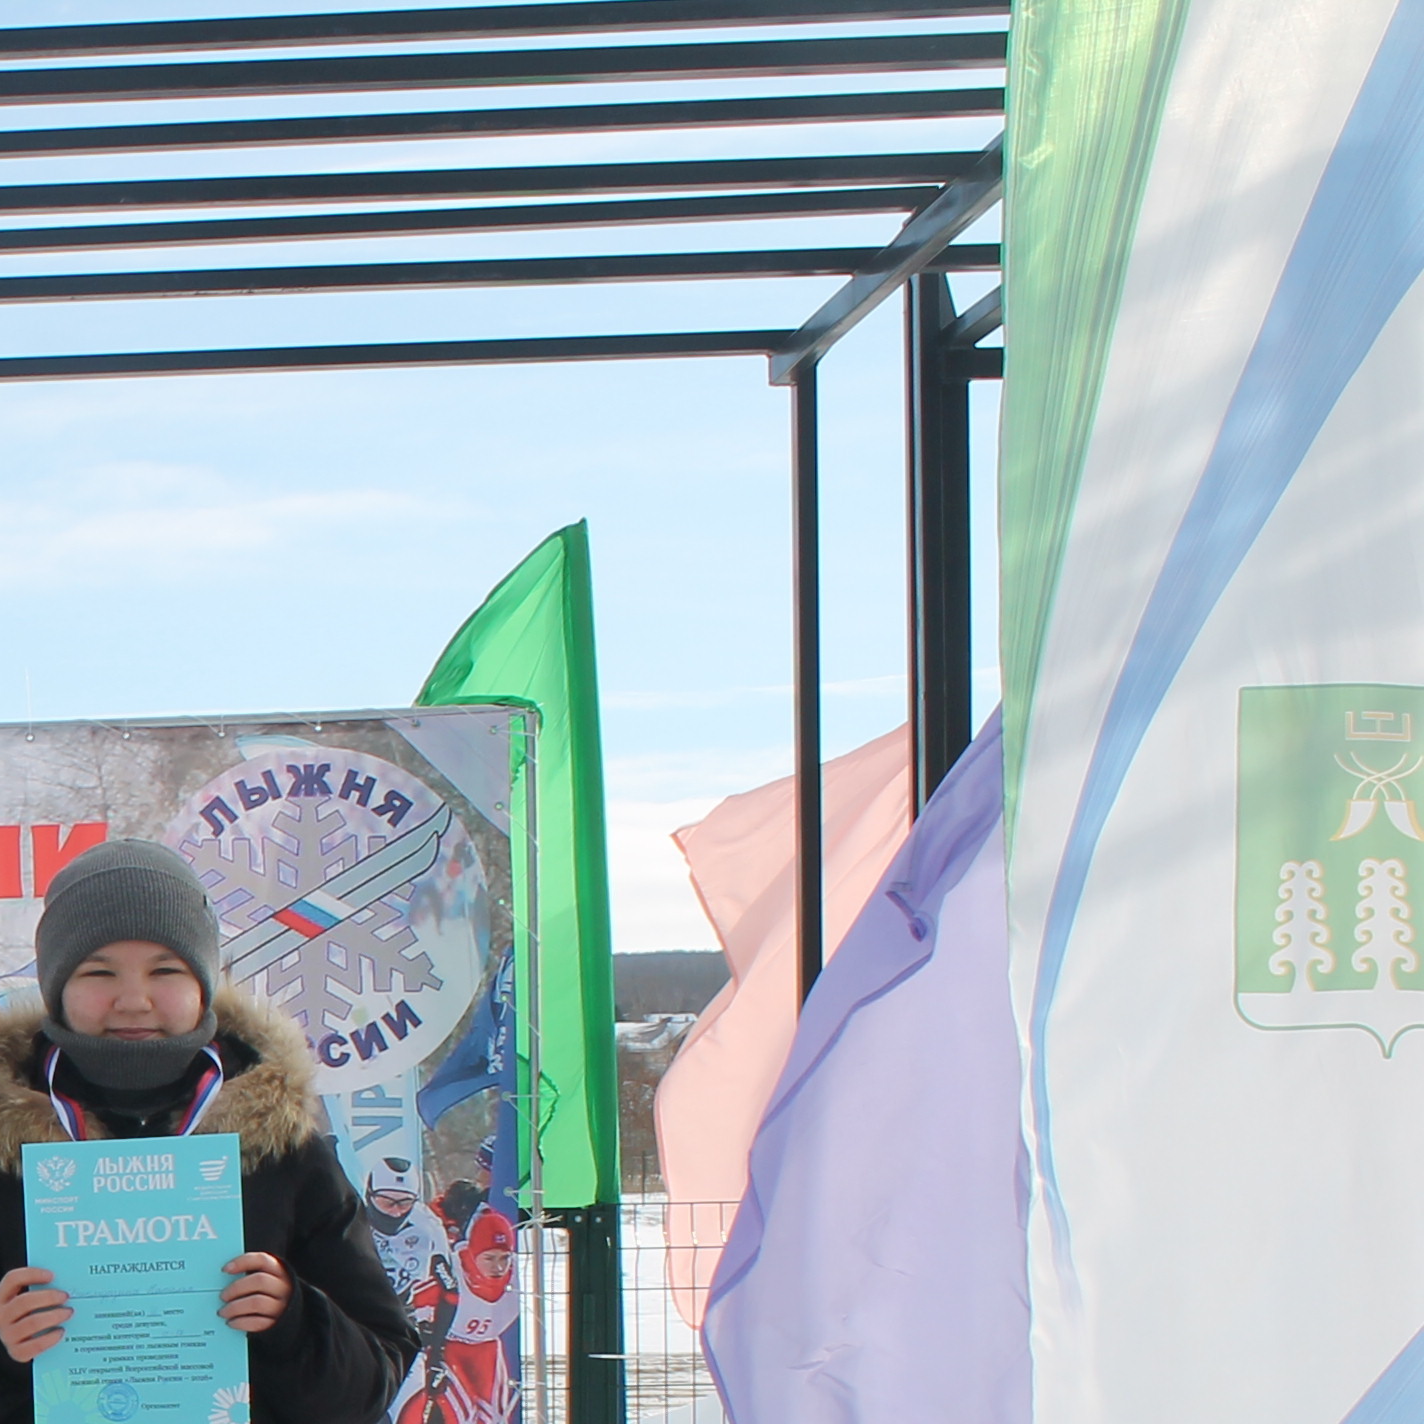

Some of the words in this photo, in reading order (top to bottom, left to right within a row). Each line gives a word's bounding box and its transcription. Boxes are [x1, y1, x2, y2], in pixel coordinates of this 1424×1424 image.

[199, 764, 414, 838] ЛЫЖНЯ
[305, 999, 422, 1068] СИИ
[92, 1153, 174, 1174] ЛЫЖНЯ
[93, 1172, 174, 1192] РОССИИ
[54, 1213, 217, 1246] ГРАМОТА
[89, 1260, 185, 1274] НАГРАЖДАЕТСЯ
[467, 1319, 491, 1335] 95
